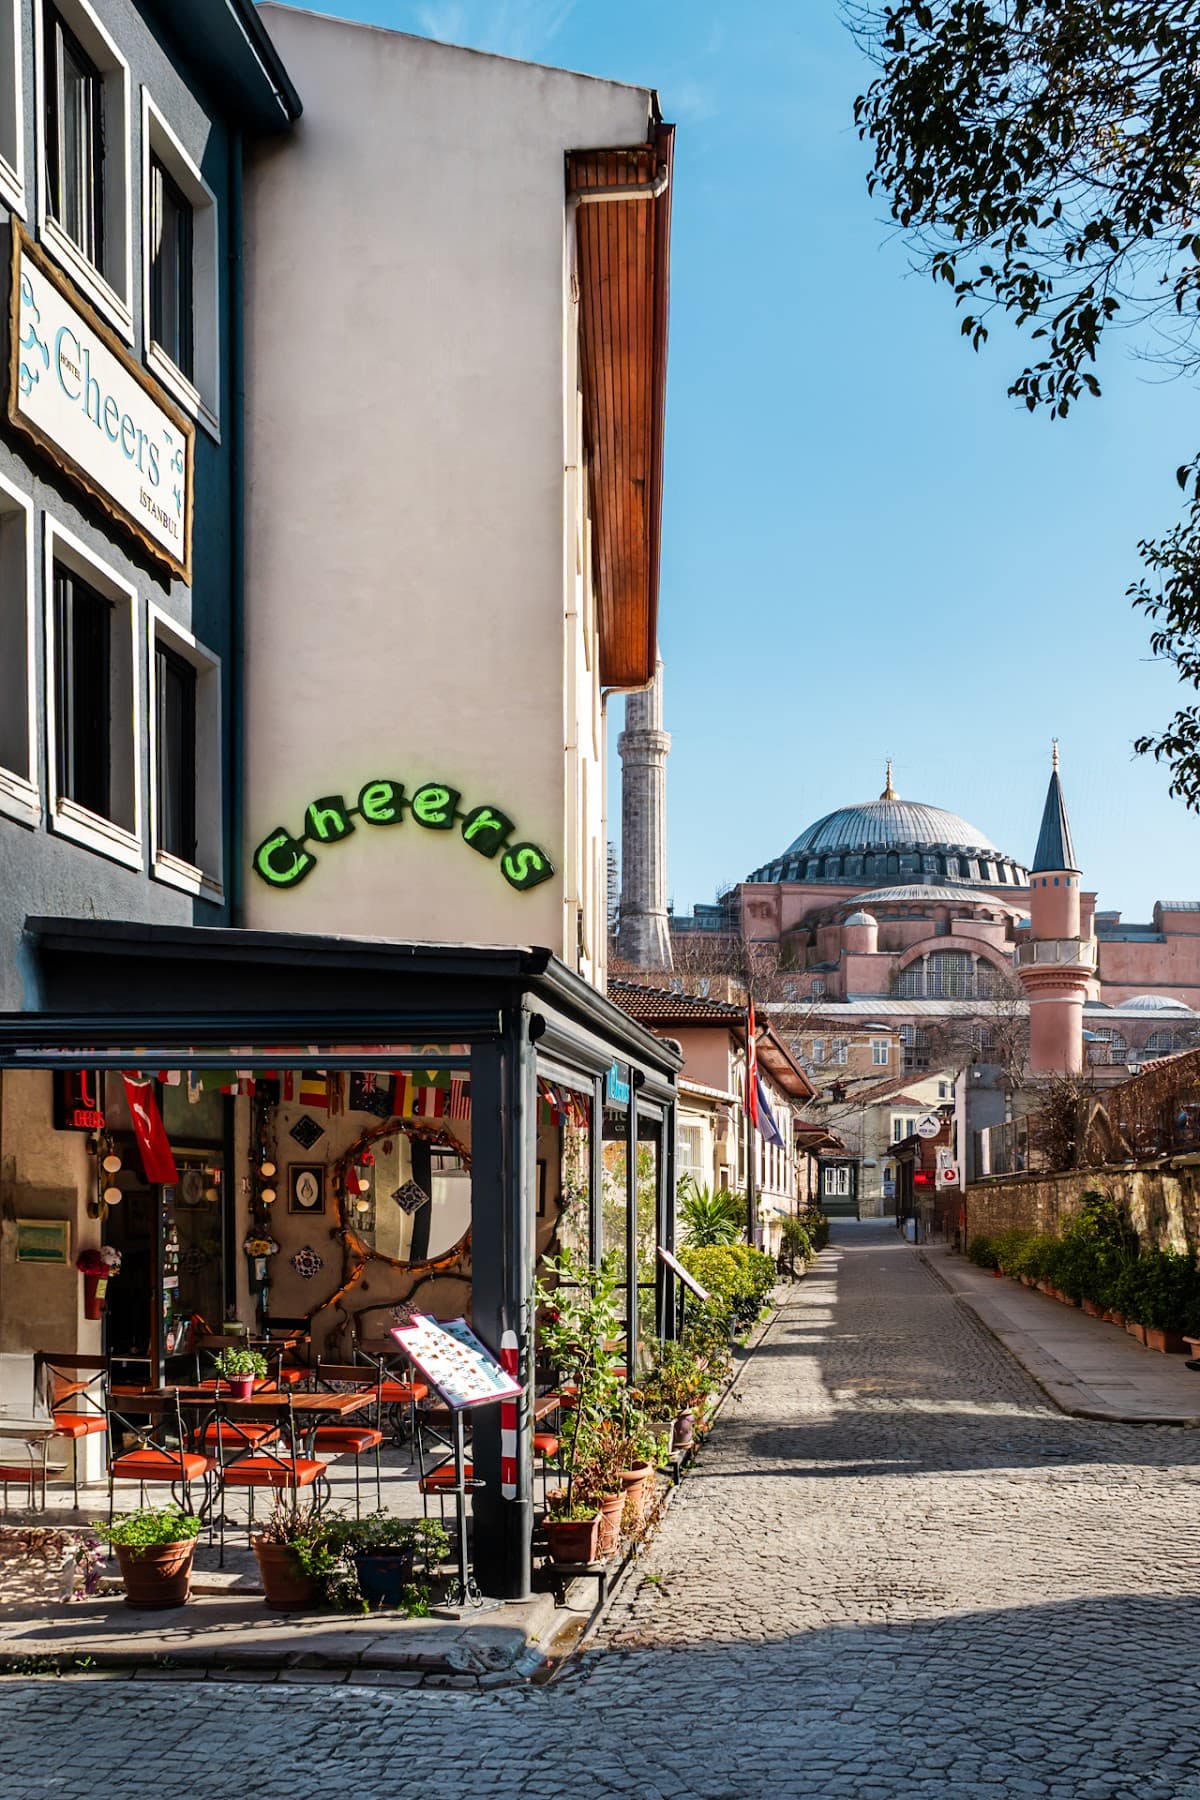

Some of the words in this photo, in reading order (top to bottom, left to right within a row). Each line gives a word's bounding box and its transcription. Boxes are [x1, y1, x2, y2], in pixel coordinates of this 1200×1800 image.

[55, 327, 160, 487] Cheers
[60, 354, 81, 380] HOSTEL
[256, 783, 544, 883] Cheers
